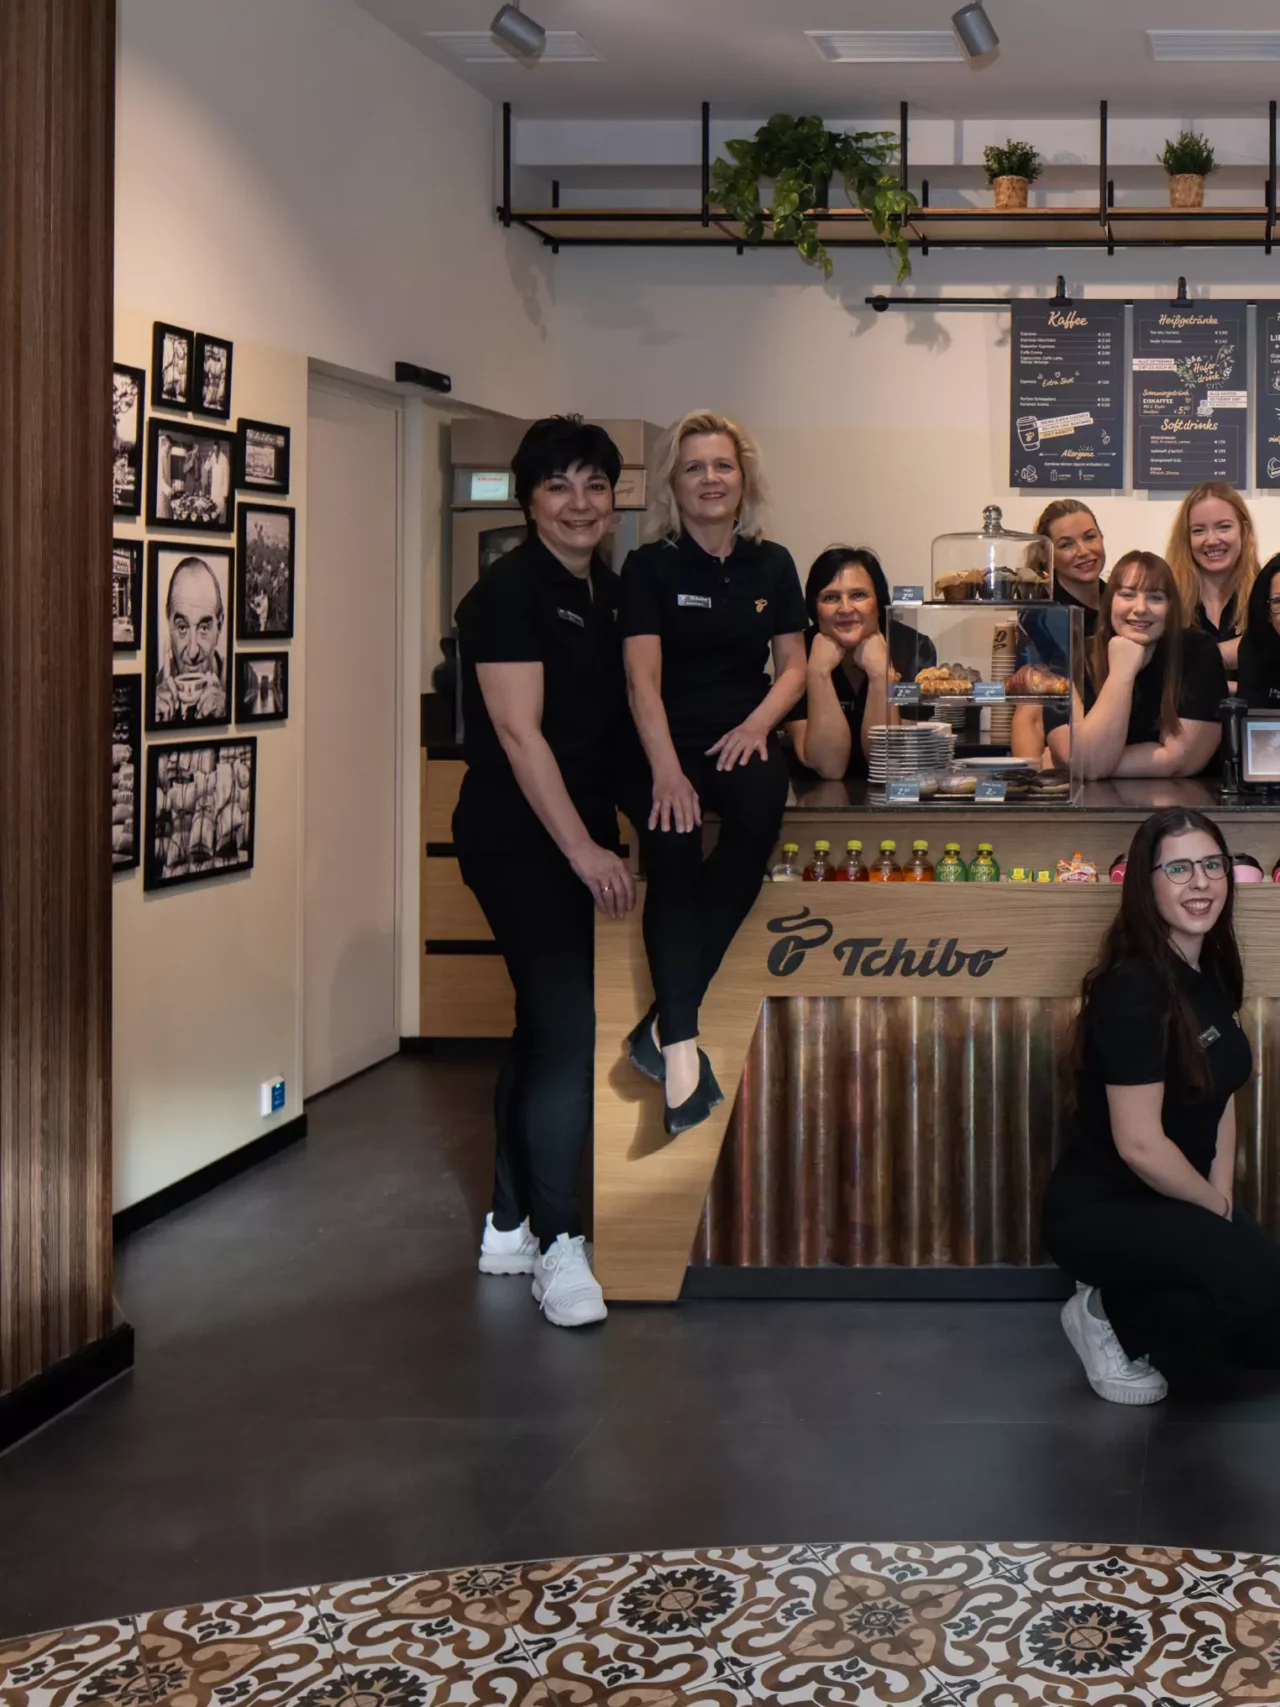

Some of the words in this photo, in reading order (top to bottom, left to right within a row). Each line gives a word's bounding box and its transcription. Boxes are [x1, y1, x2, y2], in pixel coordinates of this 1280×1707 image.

[1048, 311, 1088, 329] Kaffee
[1159, 314, 1218, 328] Heißgetränke
[1060, 377, 1074, 385] Shot
[1161, 418, 1218, 432] Softdrinks
[1061, 449, 1095, 460] Allergene
[937, 865, 962, 877] happy
[940, 870, 957, 882] day
[970, 865, 996, 877] happy
[975, 870, 991, 882] day
[834, 938, 1008, 977] Tchibo
